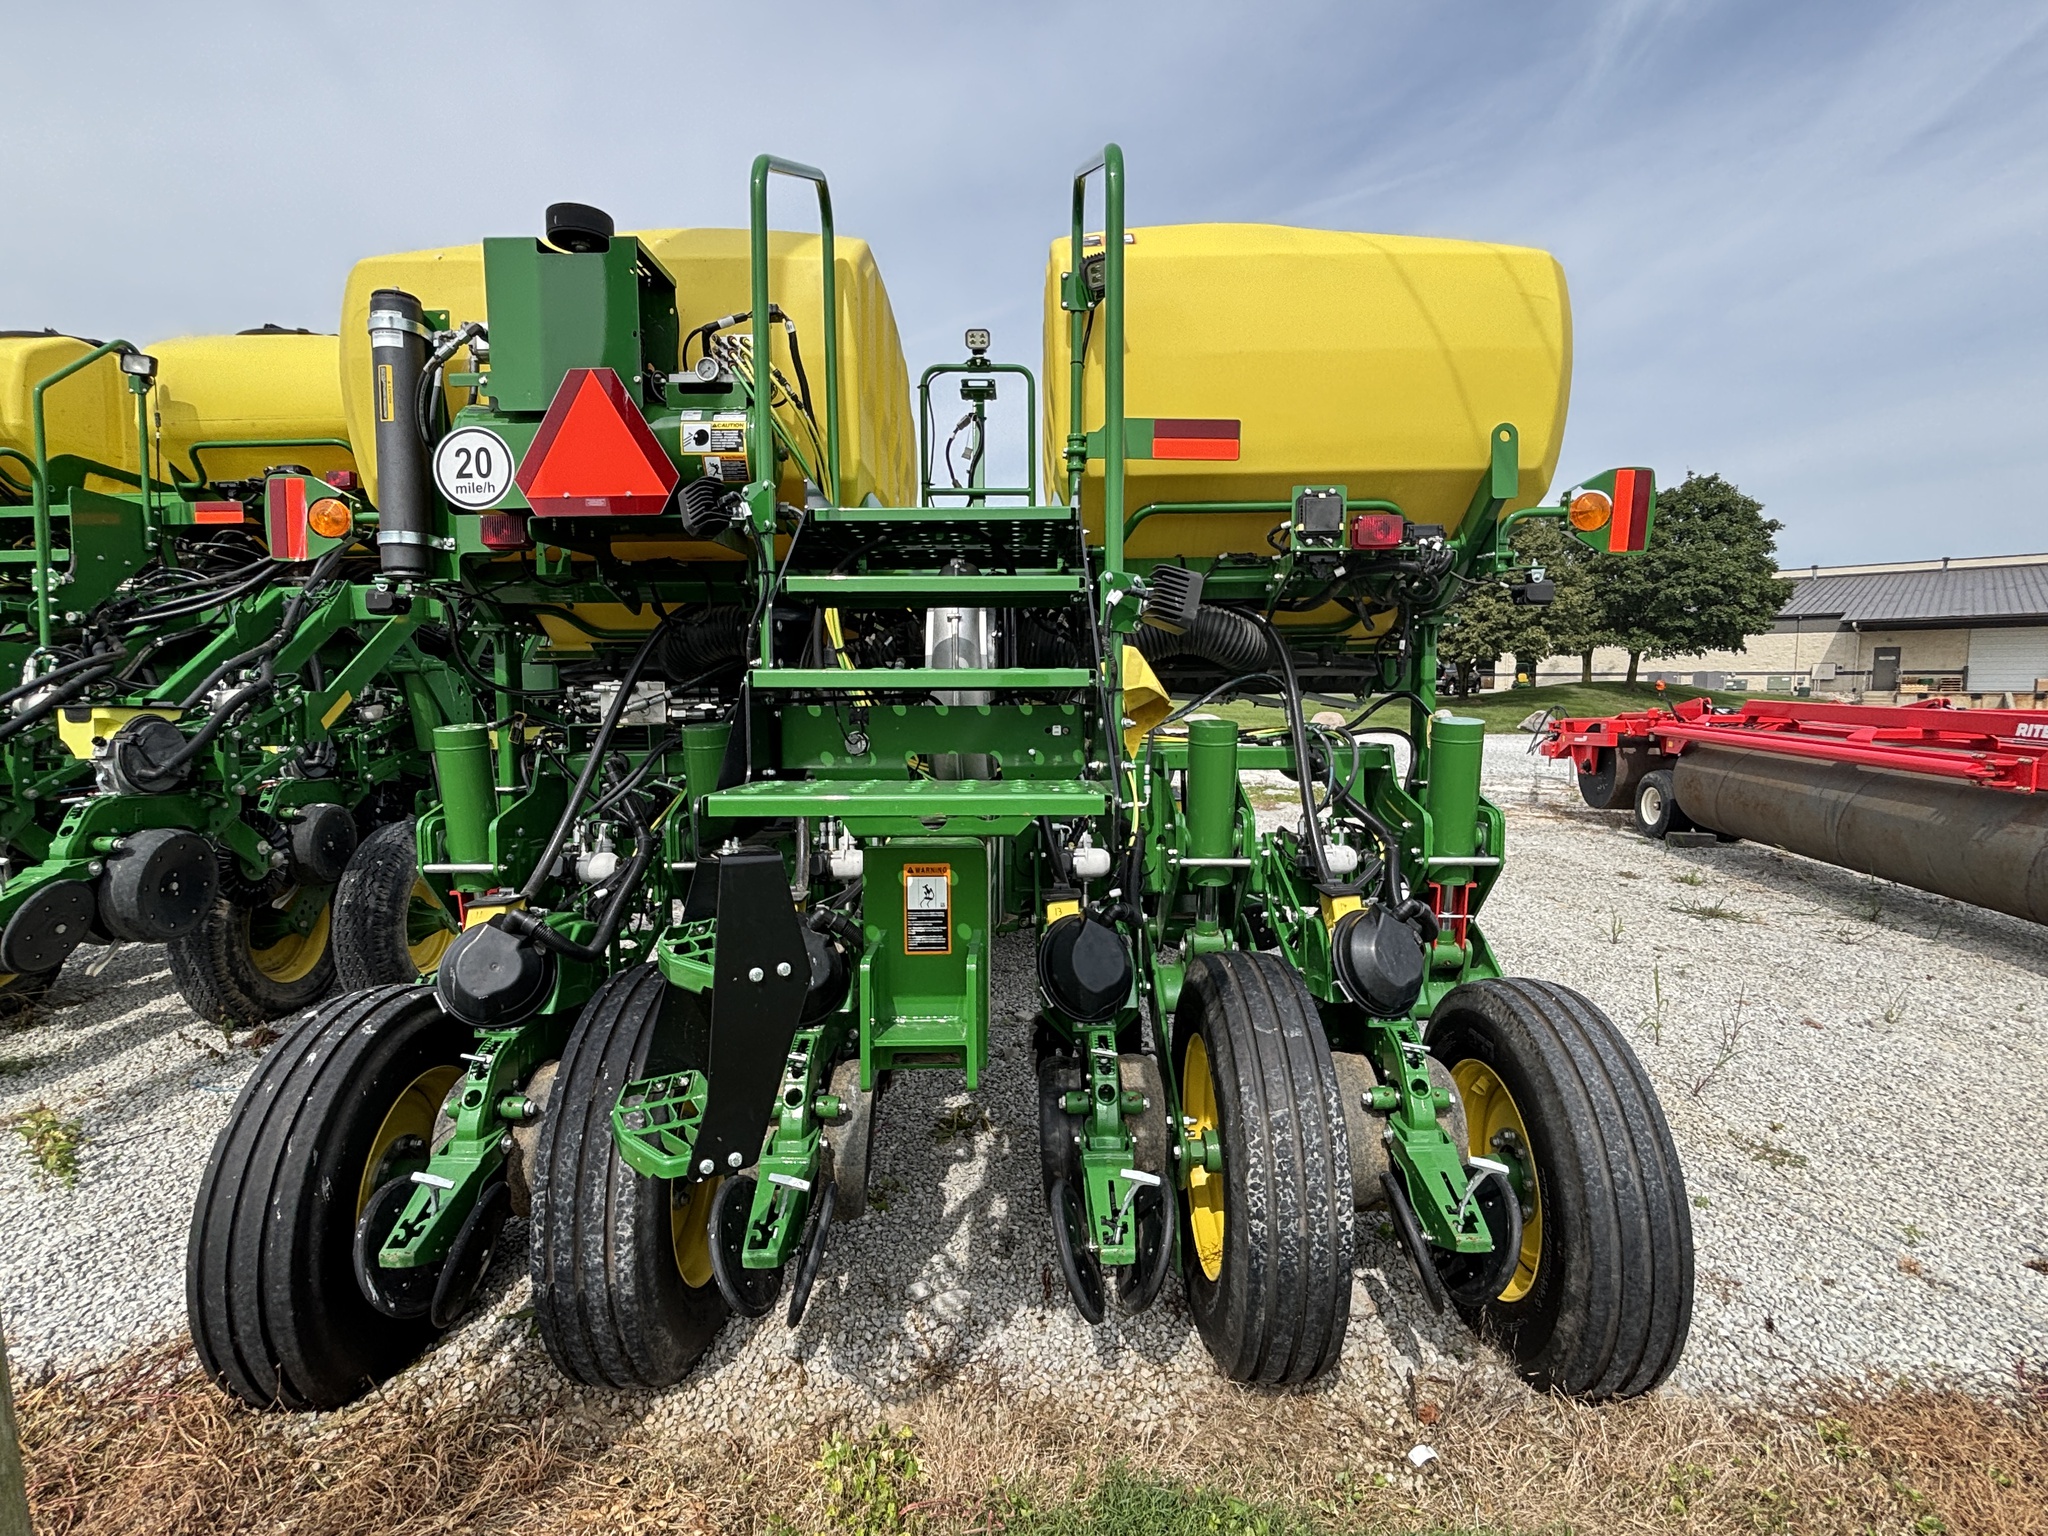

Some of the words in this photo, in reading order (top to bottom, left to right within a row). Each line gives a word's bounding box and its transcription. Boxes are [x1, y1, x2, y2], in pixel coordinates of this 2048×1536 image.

[455, 446, 492, 479] 20
[455, 481, 496, 494] mile/h
[2015, 722, 2048, 739] RITE
[915, 866, 948, 874] WARNING
